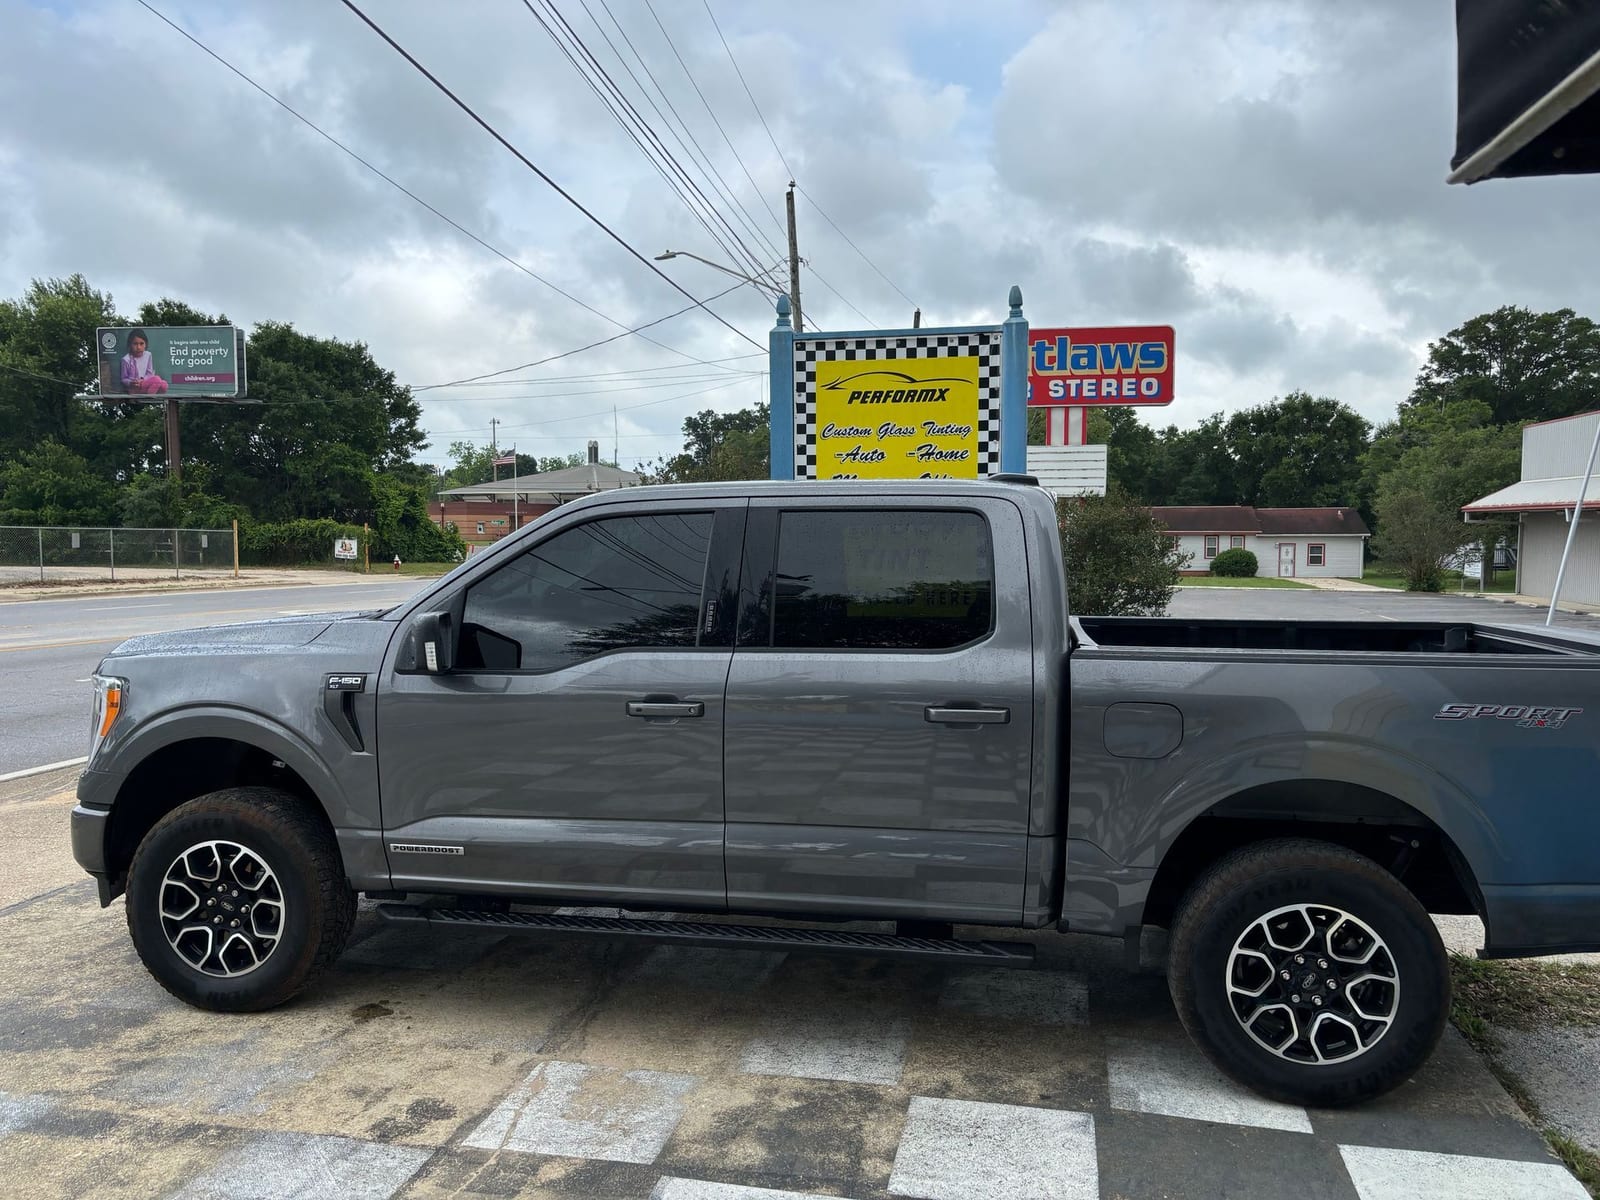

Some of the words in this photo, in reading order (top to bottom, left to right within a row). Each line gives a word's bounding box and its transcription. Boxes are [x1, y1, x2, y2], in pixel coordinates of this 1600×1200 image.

[170, 346, 188, 356] End
[191, 347, 229, 358] poverty
[1029, 336, 1168, 375] tlaws
[170, 356, 185, 366] for
[187, 355, 213, 368] good
[1048, 377, 1161, 398] STEREO
[847, 388, 951, 404] PERFORMX
[820, 422, 873, 439] Custom
[876, 422, 917, 441] Glass
[921, 420, 973, 440] Tinting
[329, 677, 361, 685] F-150
[1433, 703, 1583, 720] SPORT
[393, 845, 460, 854] POWERBOOST
